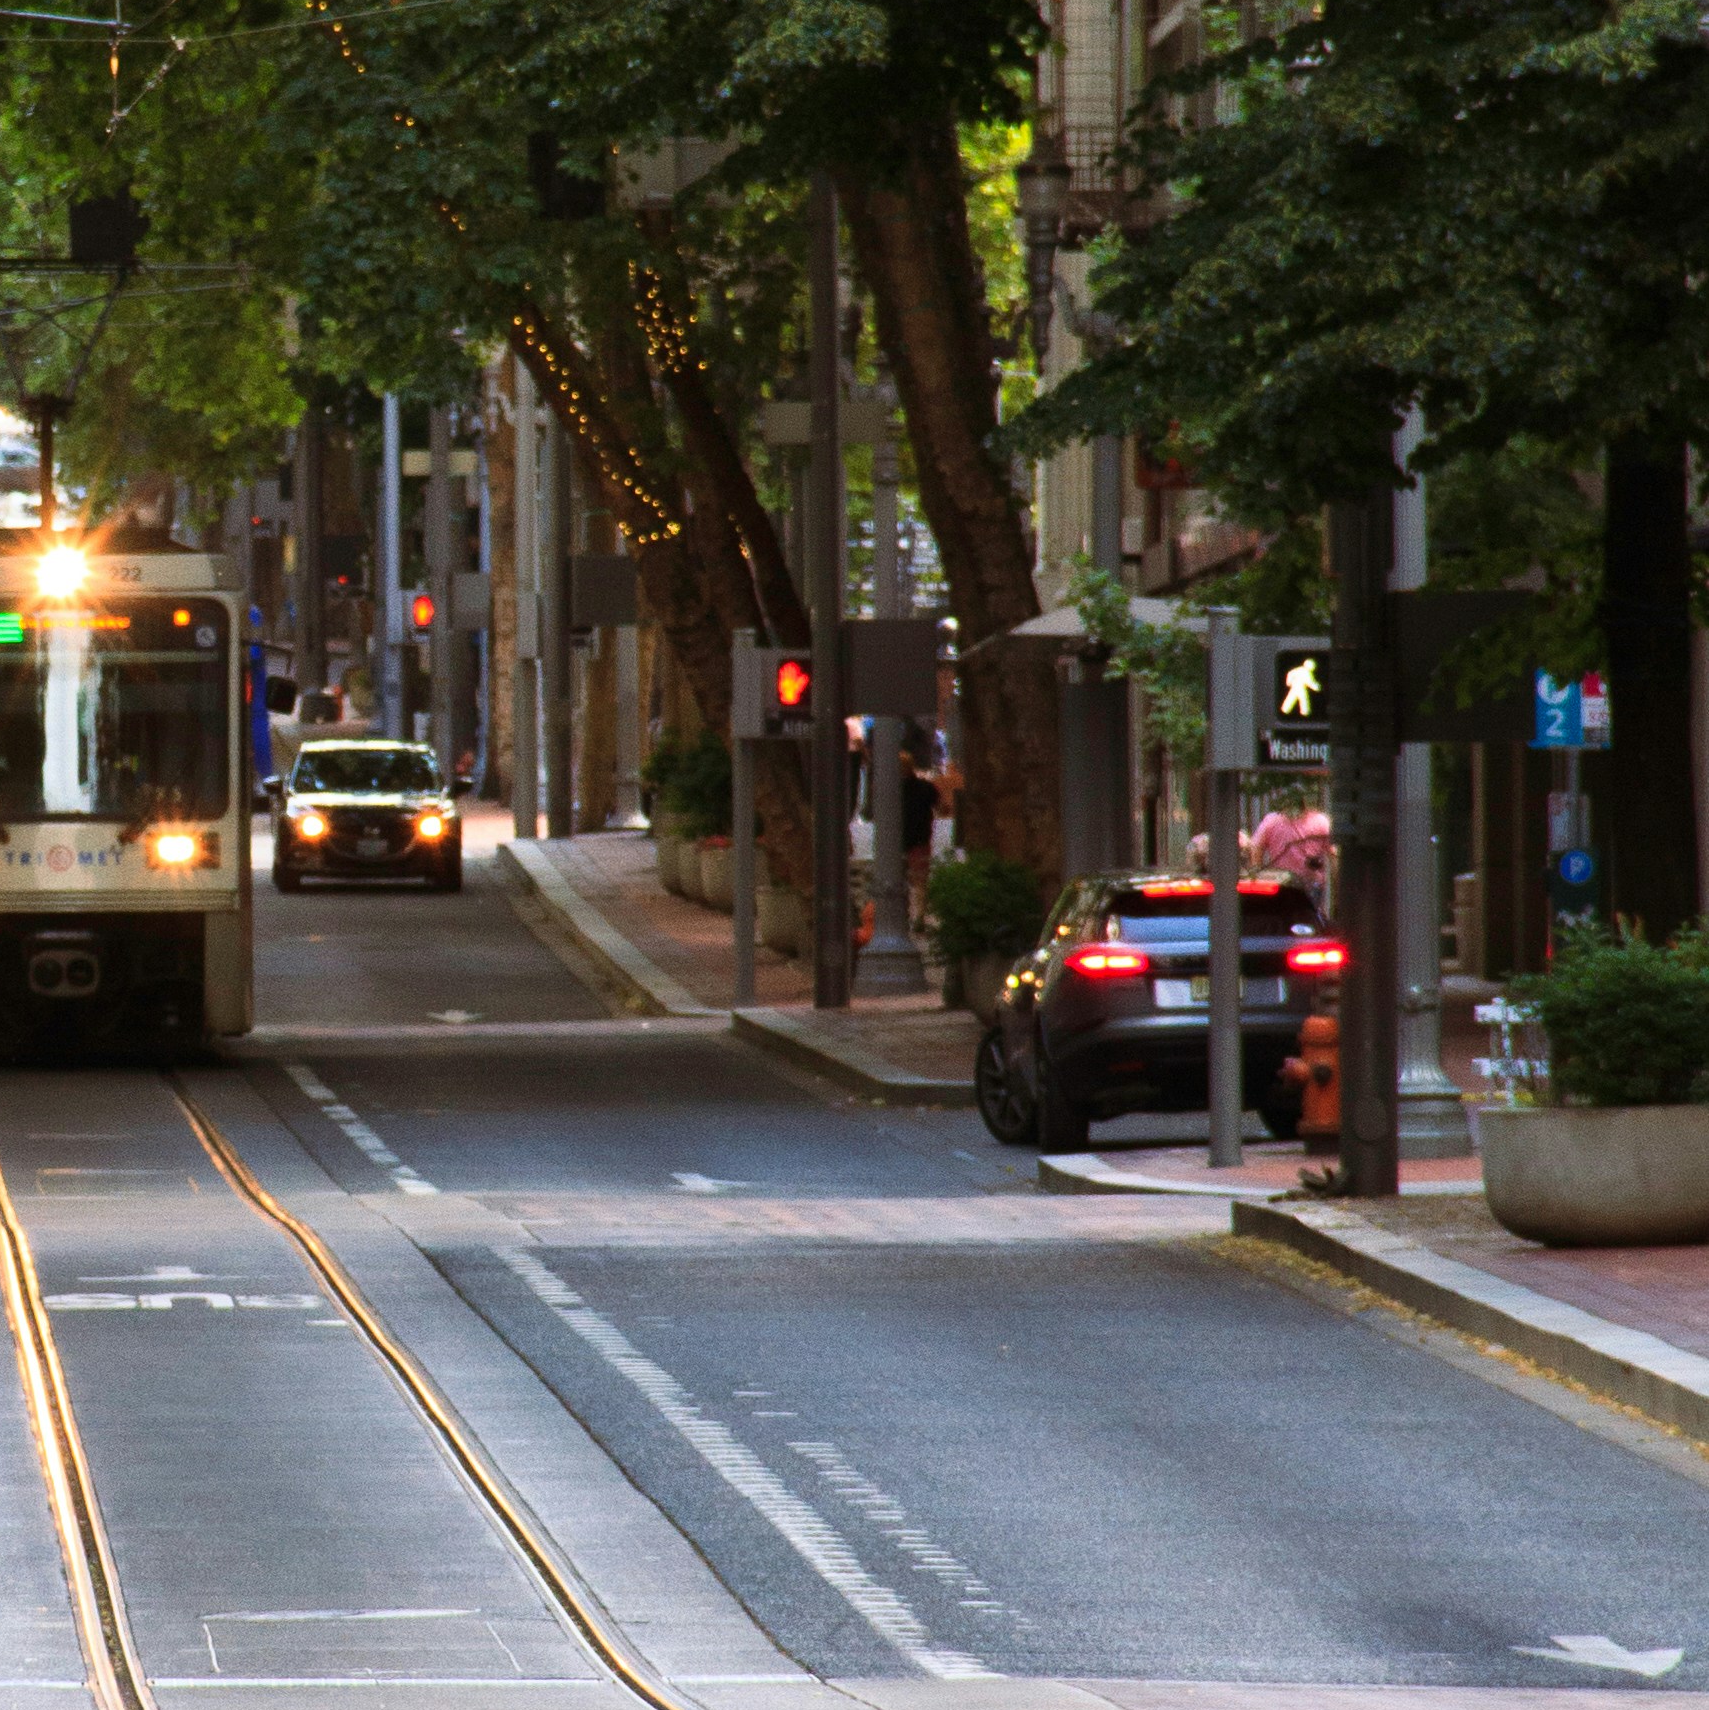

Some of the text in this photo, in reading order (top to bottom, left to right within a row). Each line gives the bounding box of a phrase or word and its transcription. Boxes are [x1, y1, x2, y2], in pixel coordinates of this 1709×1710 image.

[108, 564, 142, 582] 222
[782, 719, 810, 735] Alde
[1269, 738, 1330, 765] Washing
[5, 850, 123, 866] TRI MET
